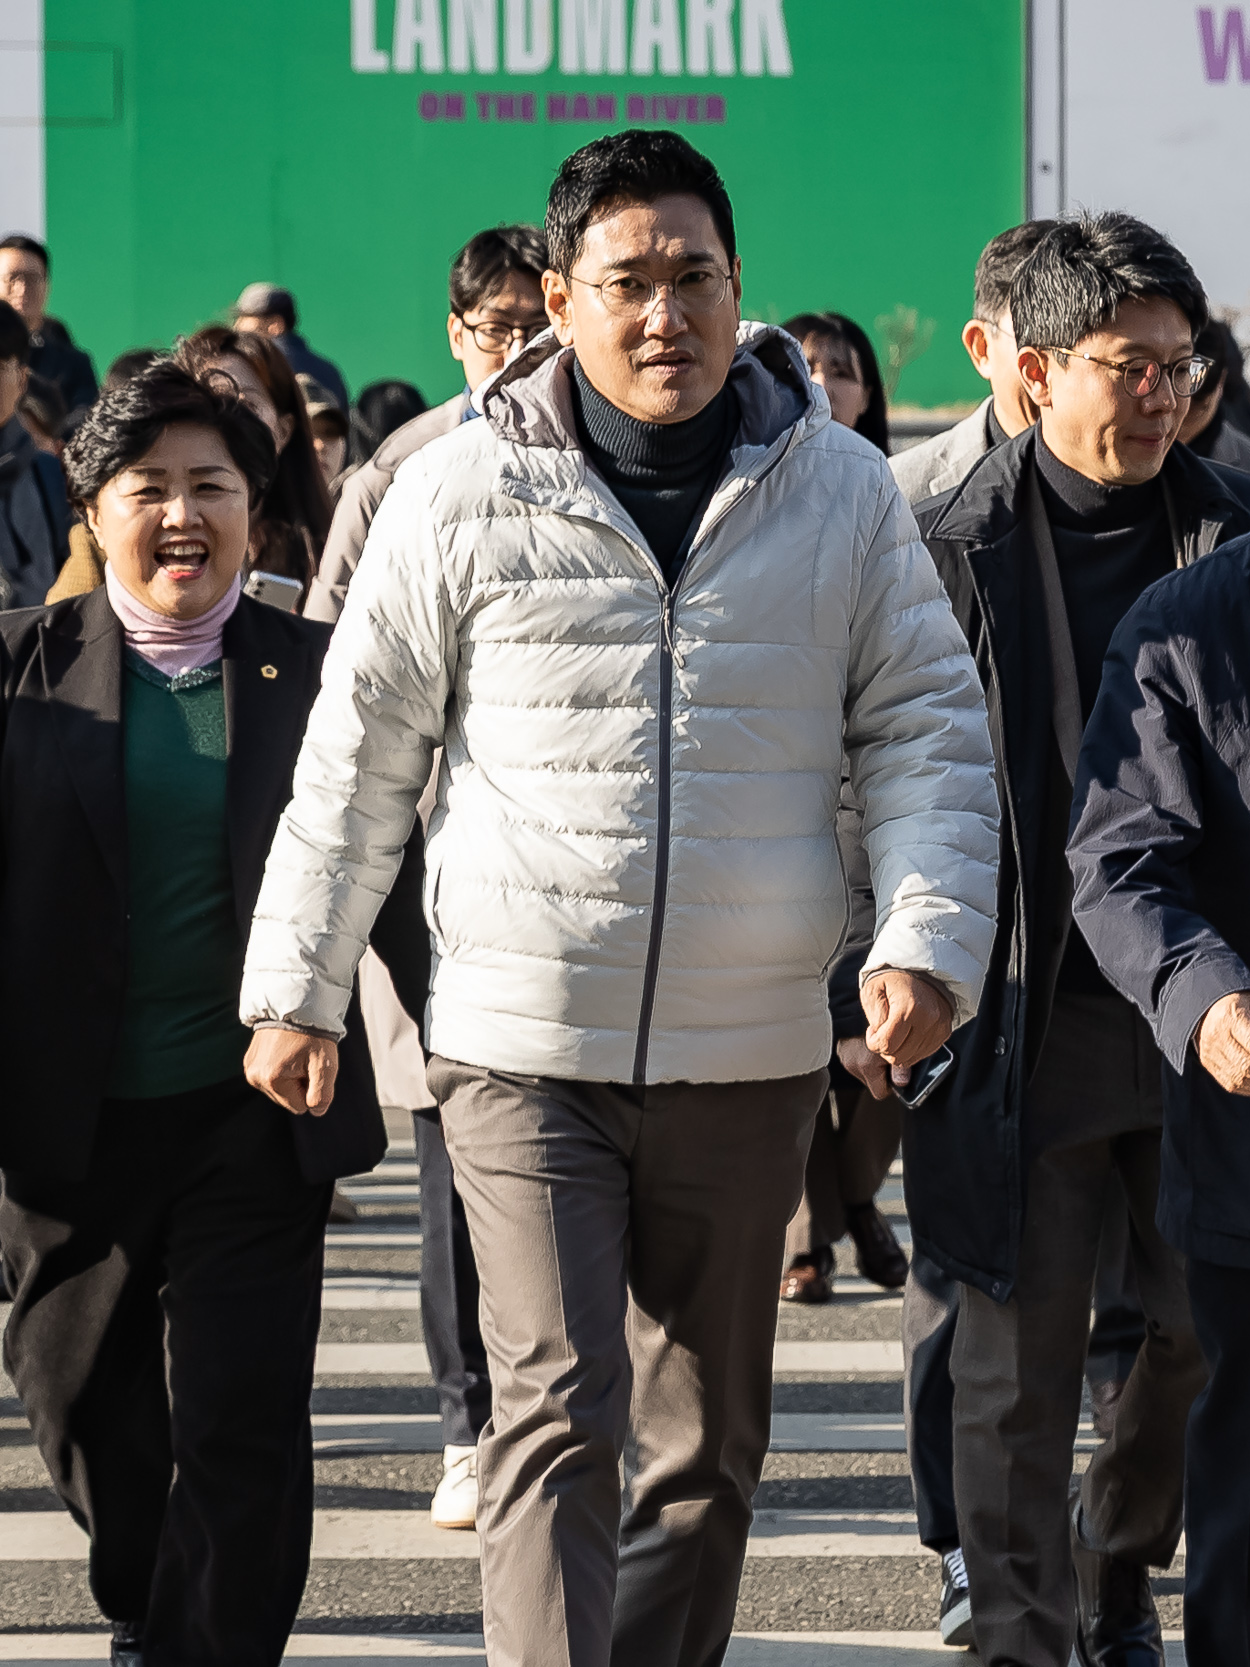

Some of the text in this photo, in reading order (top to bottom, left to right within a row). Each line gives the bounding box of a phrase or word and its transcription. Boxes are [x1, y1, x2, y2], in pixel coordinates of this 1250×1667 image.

[349, 0, 794, 77] LANDMARK
[418, 91, 466, 122] ON
[474, 91, 537, 122] THE
[626, 93, 727, 124] RIVER
